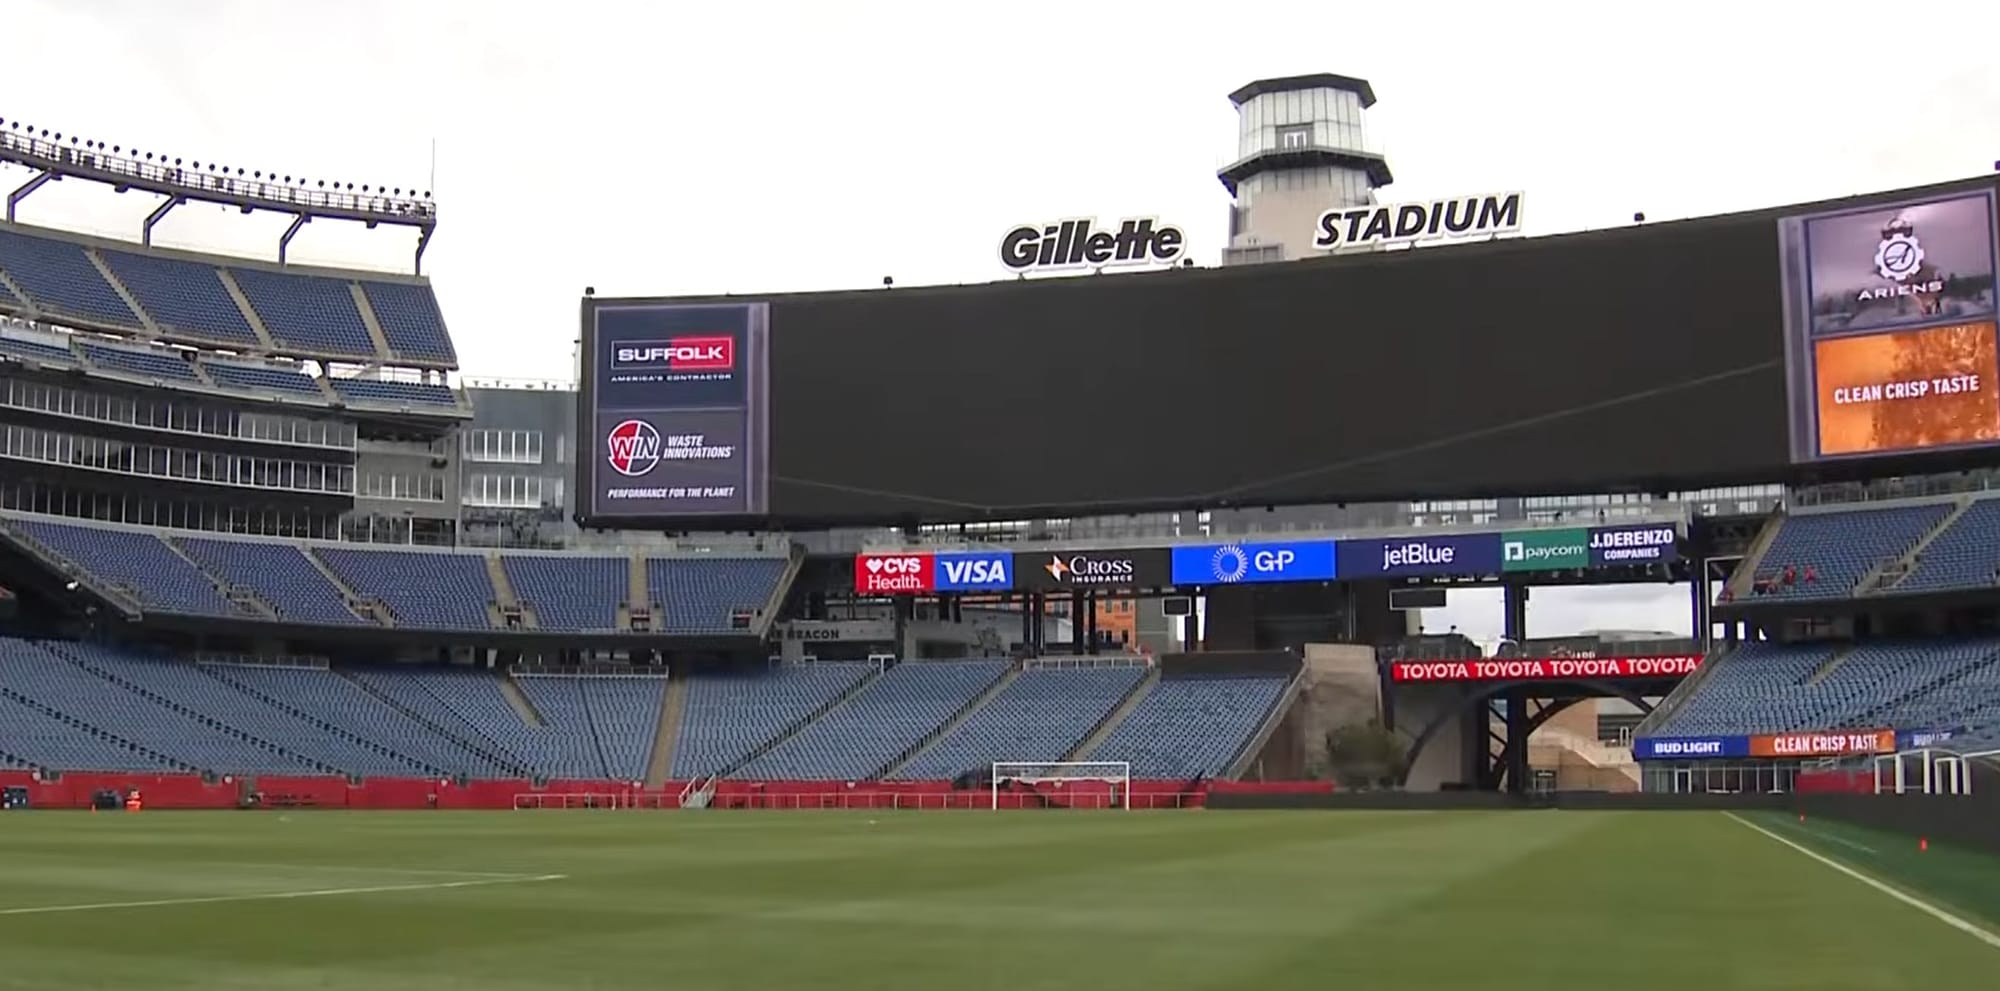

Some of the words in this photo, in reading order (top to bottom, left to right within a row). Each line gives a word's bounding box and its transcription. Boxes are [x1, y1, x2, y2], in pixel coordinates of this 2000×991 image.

[1316, 194, 1520, 246] STADIUM
[1001, 219, 1182, 268] Gillette
[1858, 282, 1943, 300] ARIENS
[618, 347, 723, 361] SUFFOLK
[1834, 385, 1882, 404] CLEAN
[1885, 381, 1929, 399] CRISP
[1932, 375, 1980, 394] TASTE
[668, 435, 704, 447] WASTE
[663, 447, 732, 459] INNOVATIONS
[608, 487, 666, 499] PERFORMANCE
[668, 487, 685, 498] FOR
[687, 487, 701, 497] THE
[703, 486, 735, 497] PLANET
[1382, 543, 1454, 570] jetBlue
[1525, 544, 1584, 560] paycom
[1604, 547, 1660, 560] COMPANIES
[884, 557, 922, 573] CVS
[941, 559, 1006, 583] VISA
[1072, 575, 1133, 583] INSURANCE
[1401, 663, 1469, 679] TOYOTA
[1475, 661, 1544, 677] TOYOTA
[1550, 660, 1621, 676] TOYOTA
[1626, 657, 1697, 673] TOYOTA
[1654, 743, 1683, 753] BUD
[1683, 741, 1721, 753] LIGHT
[1774, 737, 1811, 753] CLEAN
[1813, 735, 1846, 751] CRISP
[1849, 733, 1878, 750] TASTE
